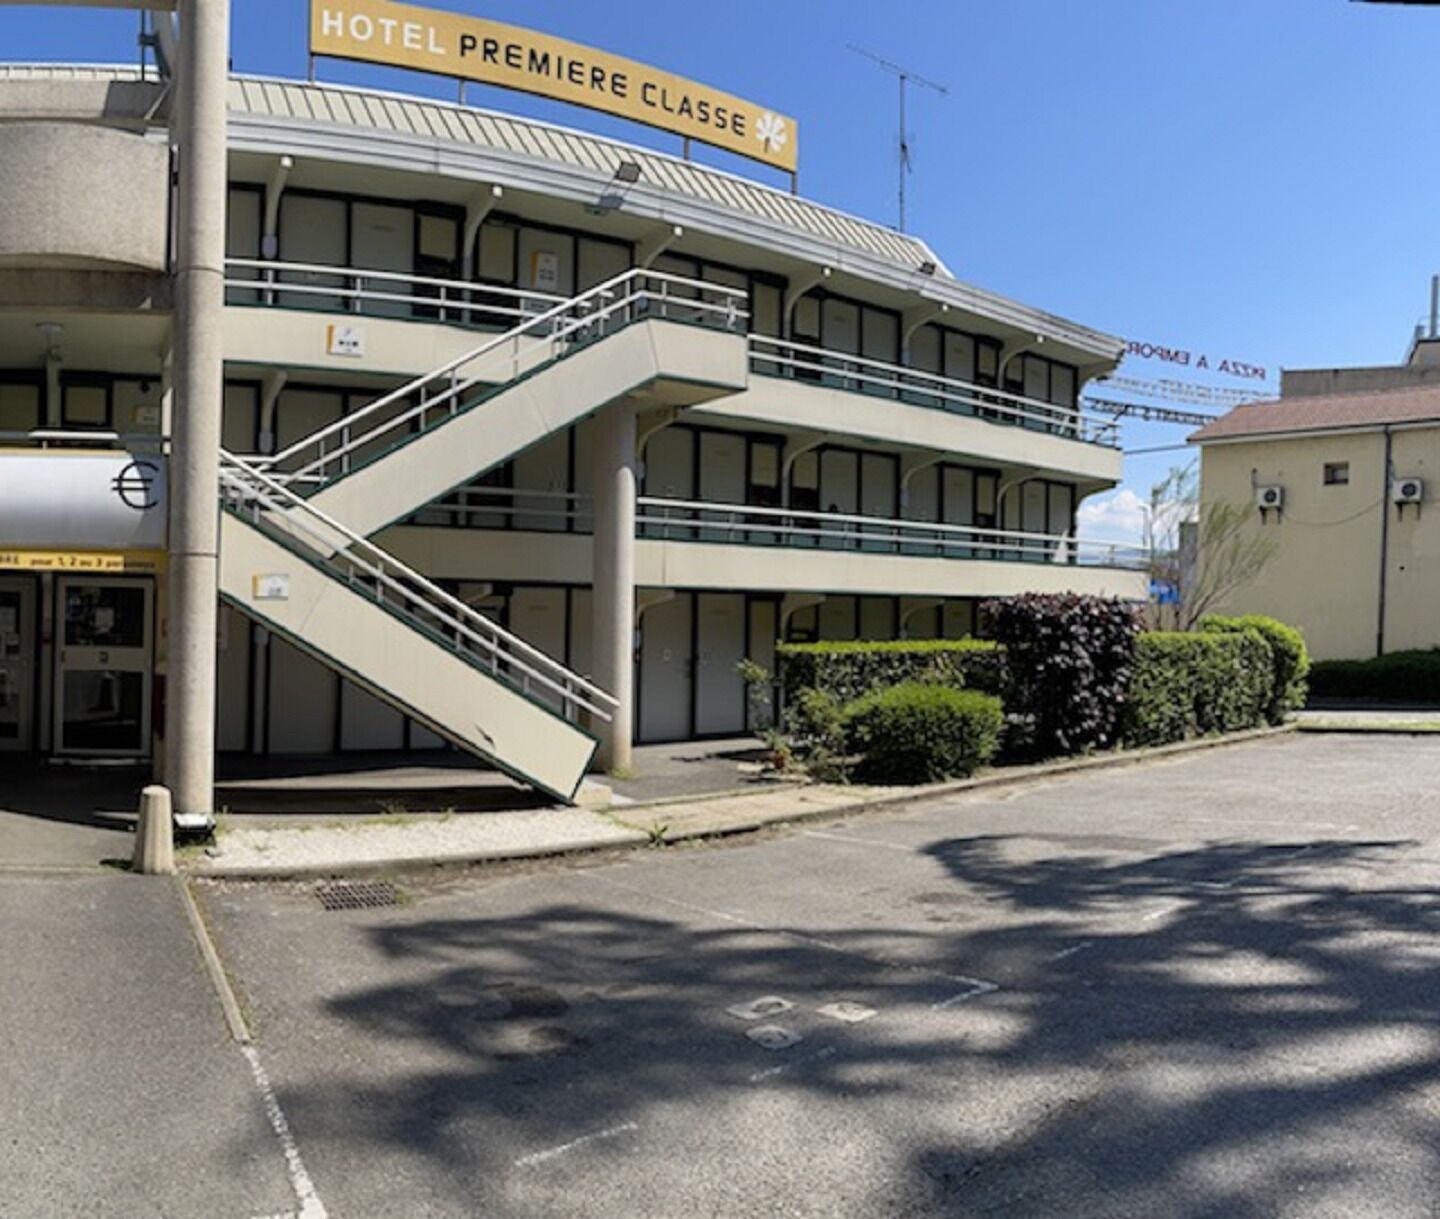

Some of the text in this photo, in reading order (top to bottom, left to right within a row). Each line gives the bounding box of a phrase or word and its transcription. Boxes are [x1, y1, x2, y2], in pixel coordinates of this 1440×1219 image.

[322, 9, 747, 137] HOTEL PREMIERE CLASSE
[111, 460, 159, 510] €
[30, 558, 52, 567] pour
[69, 557, 75, 566] 2
[96, 557, 102, 567] 3
